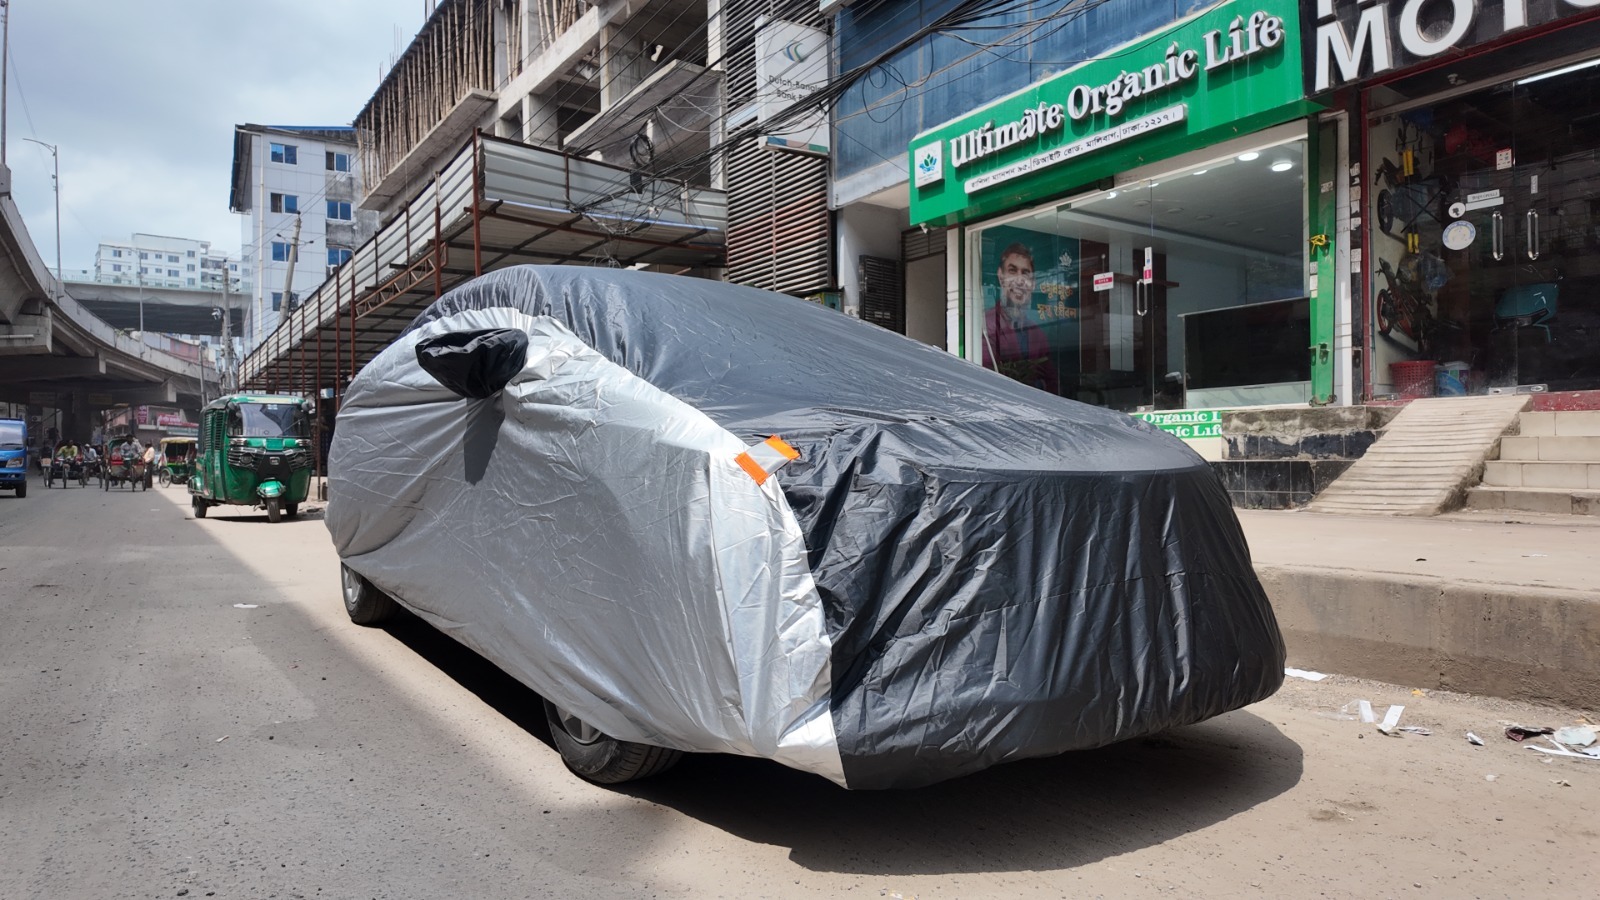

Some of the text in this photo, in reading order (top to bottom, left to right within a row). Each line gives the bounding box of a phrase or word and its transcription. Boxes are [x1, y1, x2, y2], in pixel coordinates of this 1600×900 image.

[950, 11, 1284, 168] Ultimate Organic Life
[1315, 0, 1600, 92] MO
[1143, 411, 1207, 424] Organic
